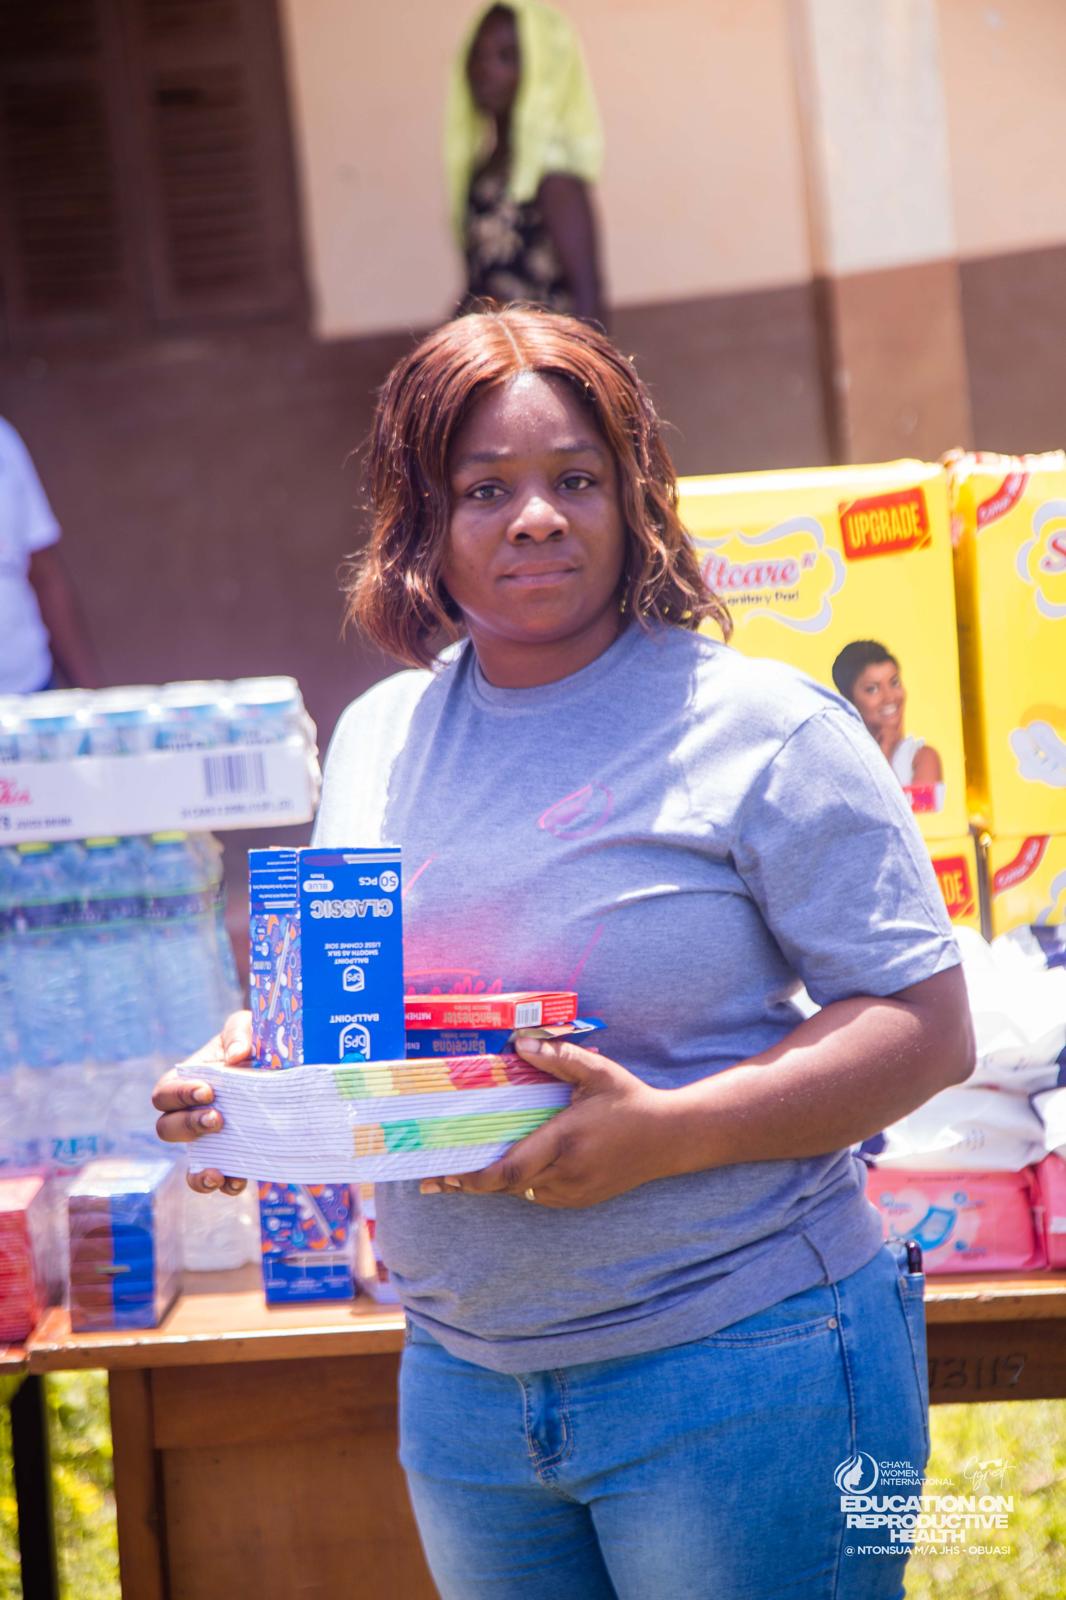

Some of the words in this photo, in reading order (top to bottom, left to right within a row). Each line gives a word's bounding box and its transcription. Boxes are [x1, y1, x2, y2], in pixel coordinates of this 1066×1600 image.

[847, 502, 923, 549] UPGRADE
[701, 553, 798, 589] ftcare
[307, 882, 329, 891] BLUE
[358, 876, 378, 886] PCS
[380, 875, 397, 887] 50
[938, 871, 966, 905] DE
[309, 898, 394, 919] CLASSIC
[334, 957, 369, 965] BALLPOINT
[329, 1012, 380, 1023] BALLPOINT
[442, 1011, 502, 1026] Manchester
[432, 1039, 486, 1054] Barcelona
